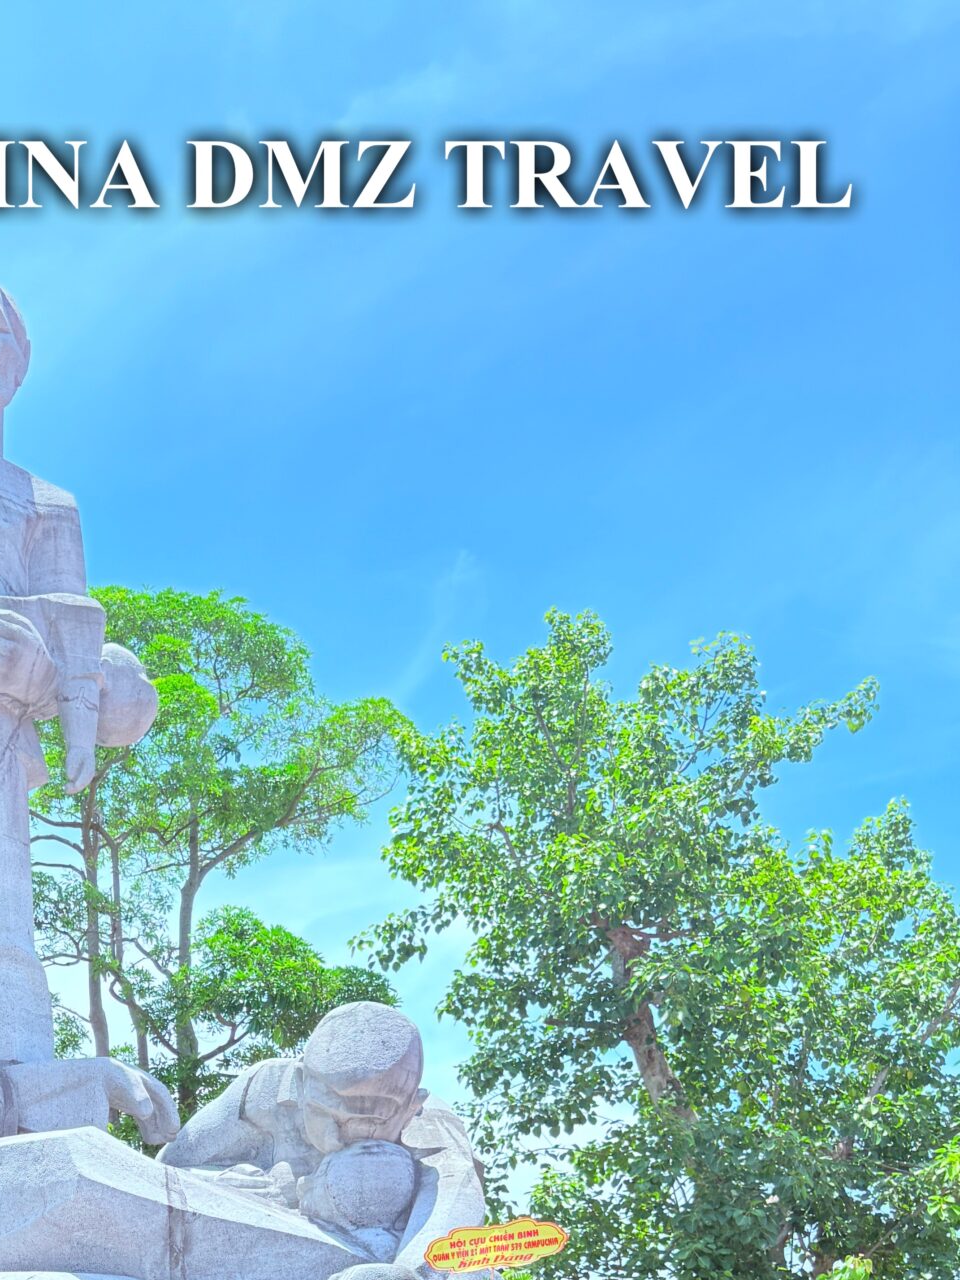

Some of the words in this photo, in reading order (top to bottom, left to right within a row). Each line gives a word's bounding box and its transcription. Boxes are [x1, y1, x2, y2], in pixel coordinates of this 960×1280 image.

[449, 1238, 466, 1250] HỘI
[469, 1237, 486, 1248] CỰU
[489, 1230, 515, 1242] CHIẾN
[517, 1229, 539, 1239] BINH
[523, 1237, 559, 1249] CAMPUCHIA
